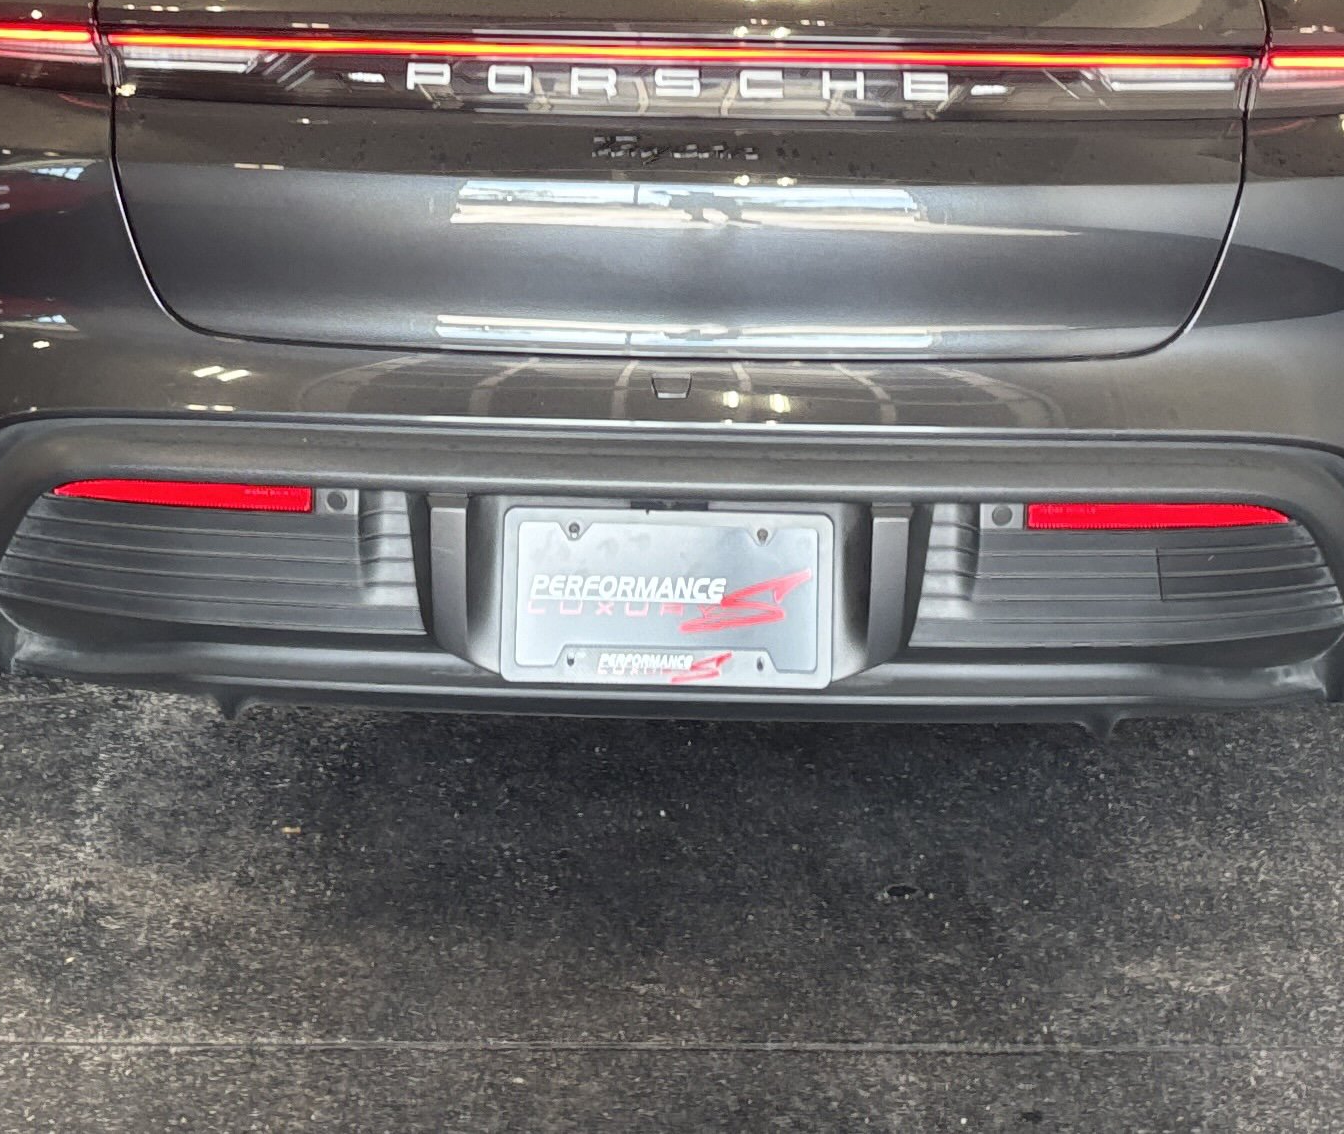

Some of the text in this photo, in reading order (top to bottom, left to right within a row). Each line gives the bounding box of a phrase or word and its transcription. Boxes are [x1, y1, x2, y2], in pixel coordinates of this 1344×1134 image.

[406, 61, 949, 101] PORSCHE
[529, 574, 726, 602] PERFORMANCE
[598, 653, 693, 670] PERFORMANCE
